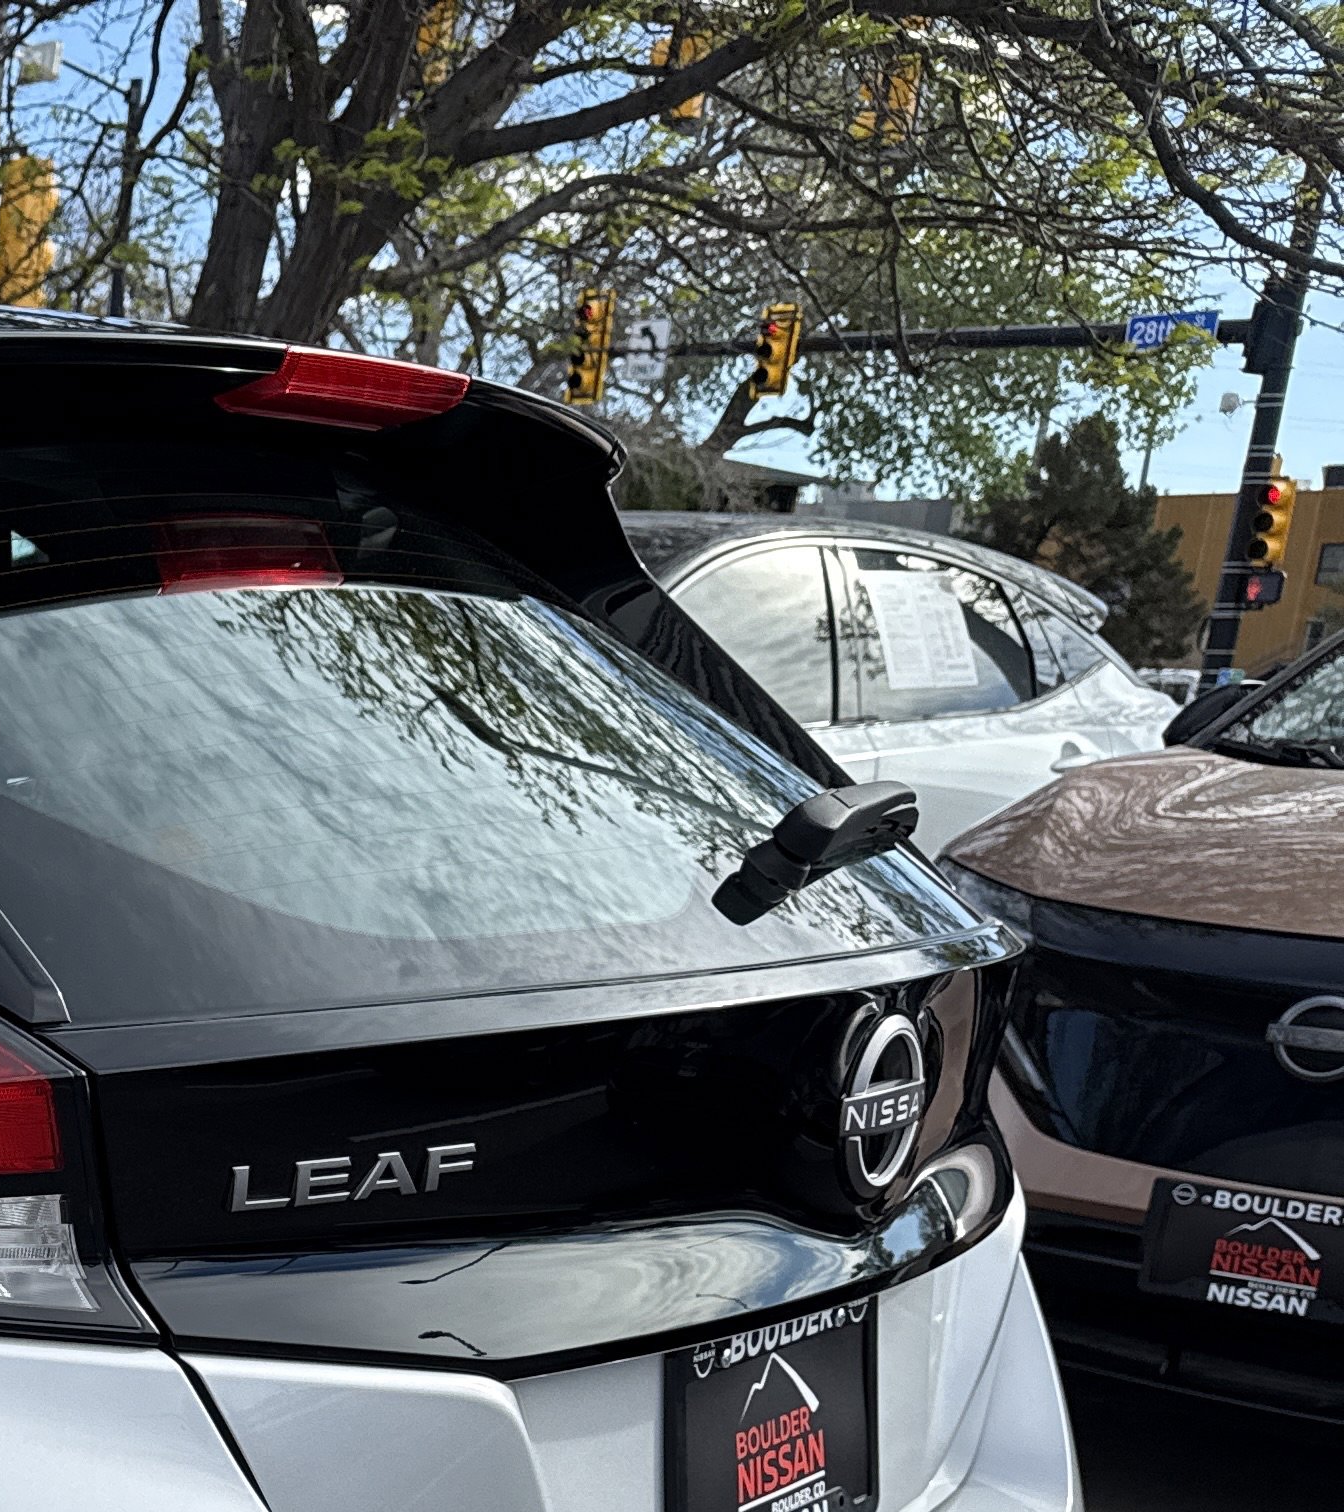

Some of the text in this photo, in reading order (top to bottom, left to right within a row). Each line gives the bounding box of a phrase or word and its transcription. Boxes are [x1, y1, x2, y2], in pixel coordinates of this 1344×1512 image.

[844, 1090, 925, 1132] NISSA
[229, 1142, 477, 1213] LEAF
[1212, 1188, 1342, 1226] BOULDER
[1211, 1251, 1323, 1288] NISSAN
[1214, 1237, 1307, 1265] BOULDER
[1205, 1282, 1309, 1317] NISSAN
[730, 1308, 834, 1364] BOULDER
[735, 1404, 811, 1461] BOULDER
[736, 1428, 826, 1504] NISSAN
[812, 1480, 826, 1498] CO
